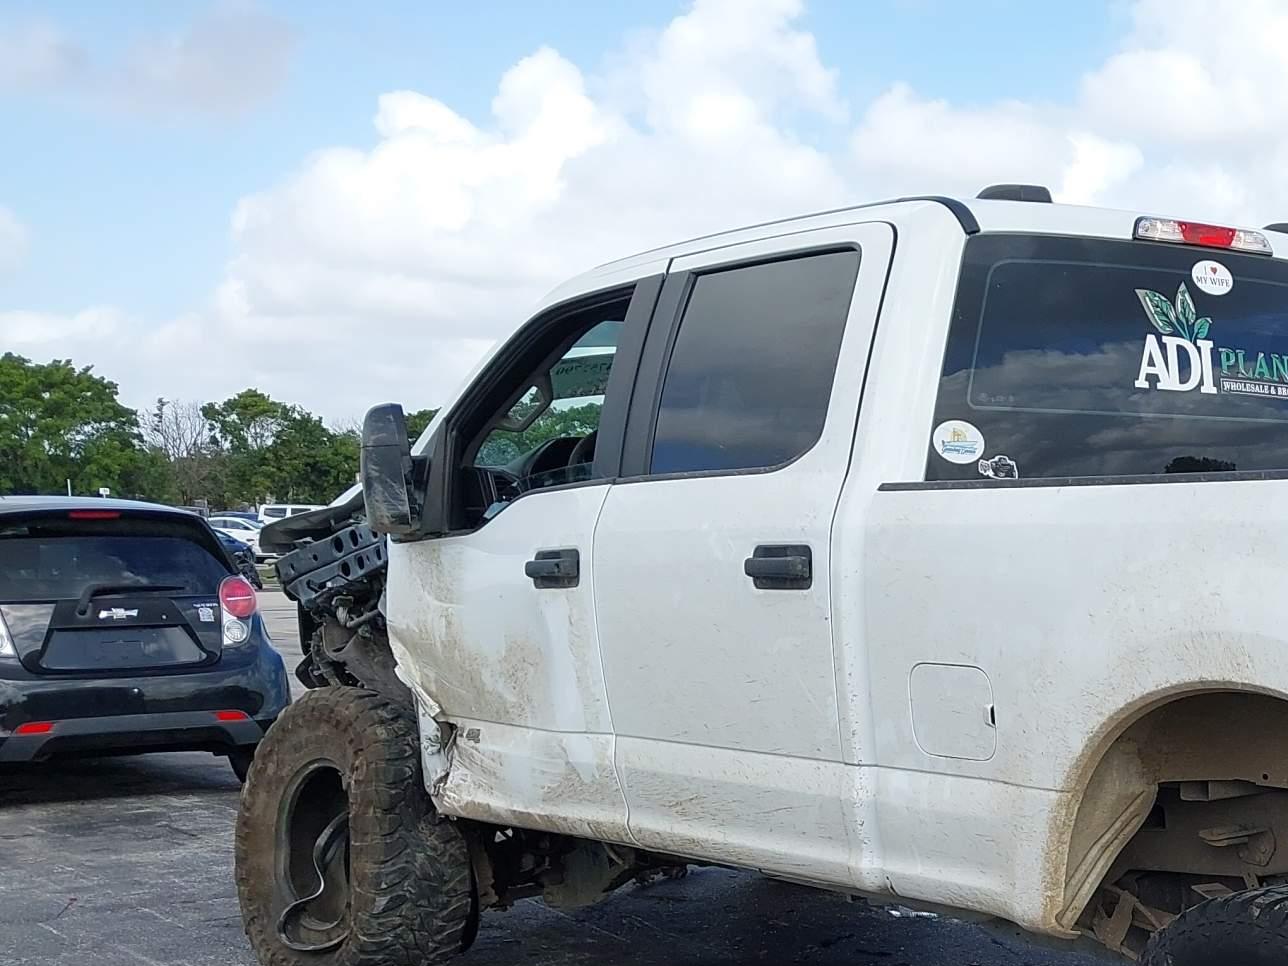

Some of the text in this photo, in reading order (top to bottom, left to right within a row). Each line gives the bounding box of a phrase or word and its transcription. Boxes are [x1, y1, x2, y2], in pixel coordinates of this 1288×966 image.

[1196, 276, 1230, 288] MY WIFE
[1135, 334, 1217, 394] ADI
[1223, 381, 1269, 394] WHOLESALE
[1270, 387, 1276, 395] &
